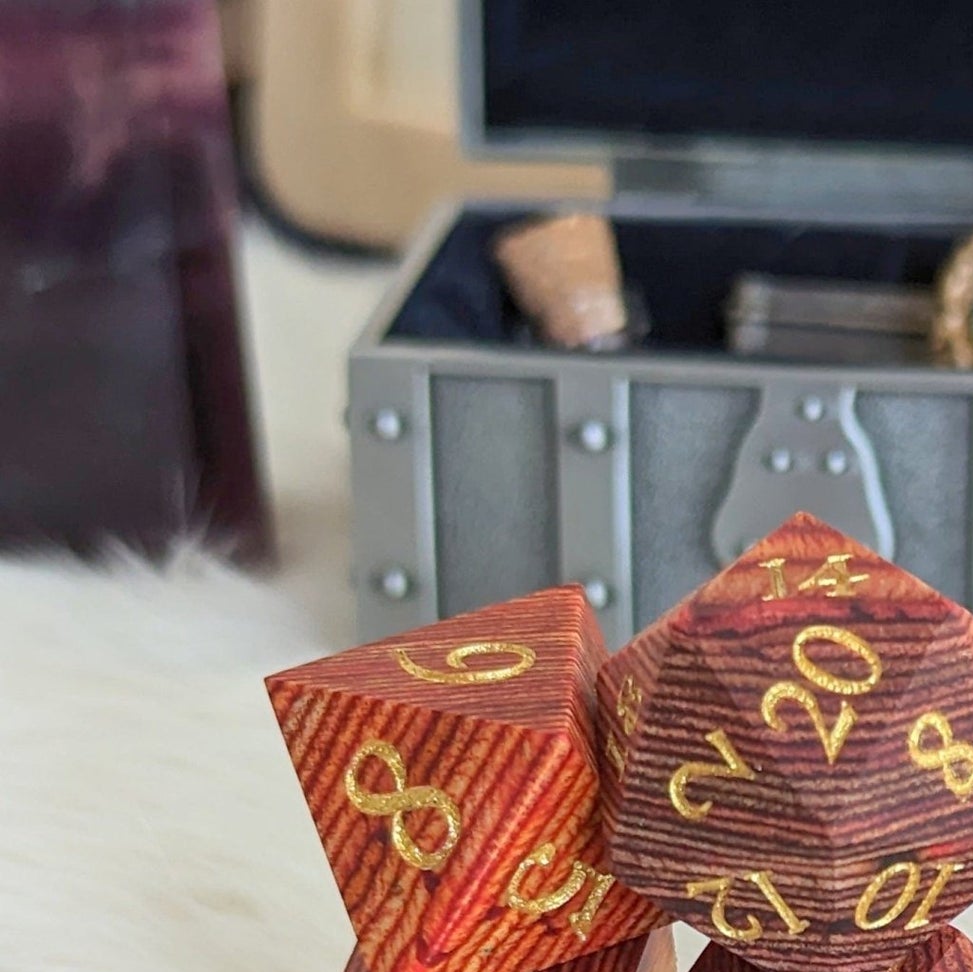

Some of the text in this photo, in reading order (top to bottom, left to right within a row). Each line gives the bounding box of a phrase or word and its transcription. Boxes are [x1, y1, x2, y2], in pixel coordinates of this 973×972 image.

[757, 553, 870, 601] 14
[760, 625, 882, 764] 20
[344, 739, 462, 871] 8
[669, 729, 756, 821] 2
[507, 842, 616, 941] 5
[686, 870, 810, 942] 12
[854, 861, 966, 932] 10
